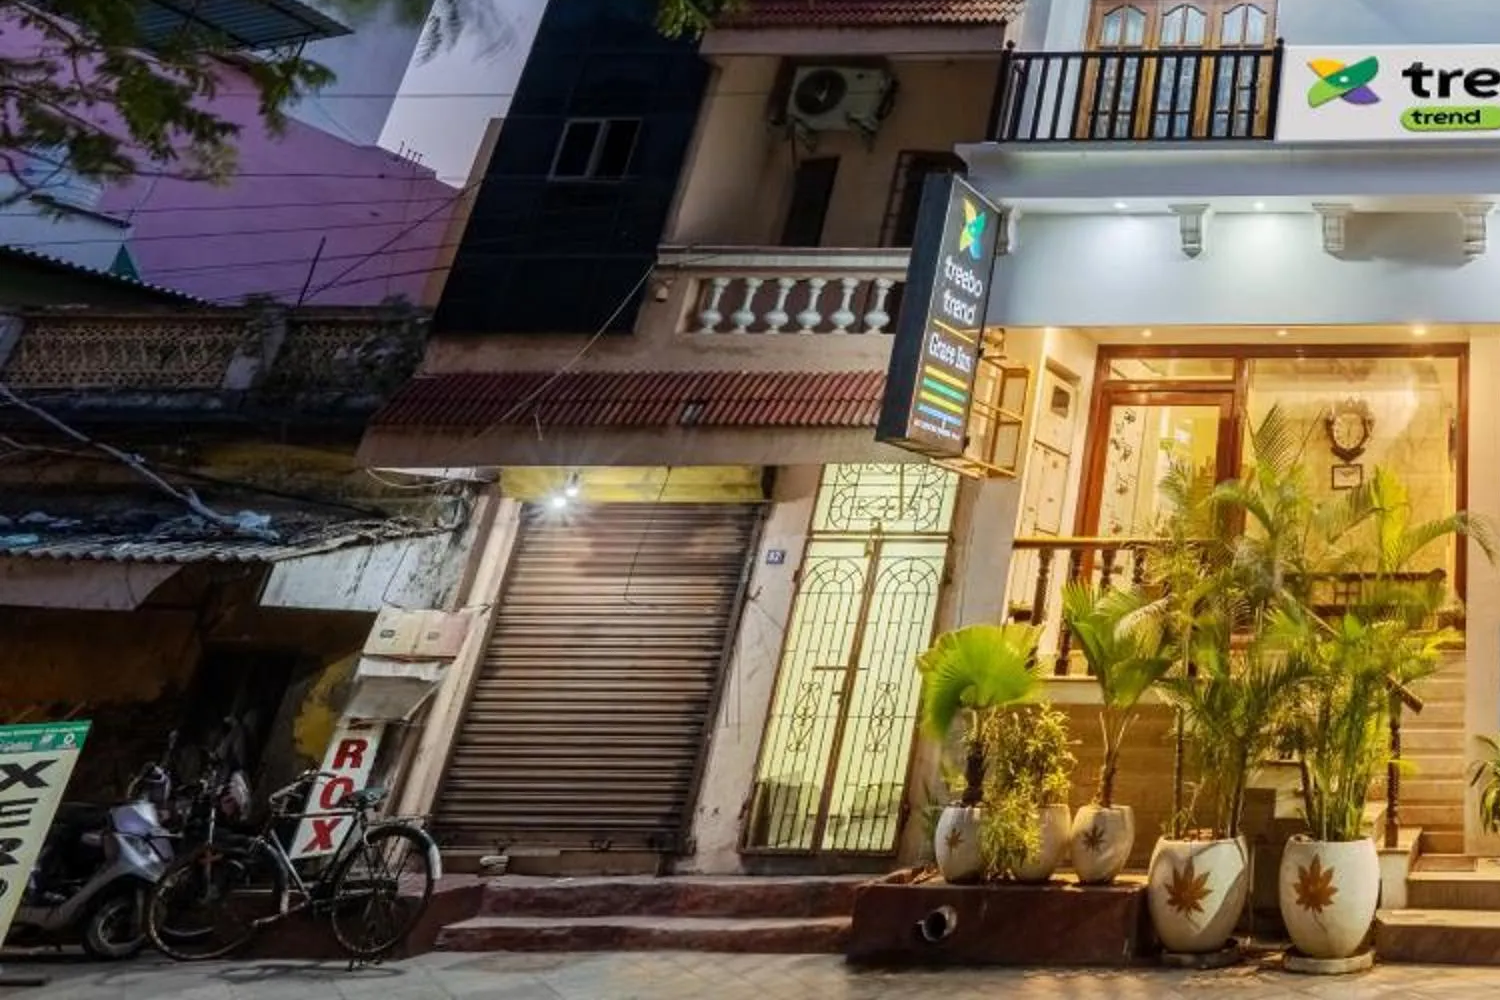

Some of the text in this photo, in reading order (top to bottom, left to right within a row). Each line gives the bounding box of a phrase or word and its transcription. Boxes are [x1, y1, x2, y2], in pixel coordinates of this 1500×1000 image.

[1410, 109, 1481, 125] trend
[944, 255, 983, 298] treebo
[943, 288, 977, 325] trend
[929, 332, 956, 366] Grace
[0, 758, 59, 899] XER
